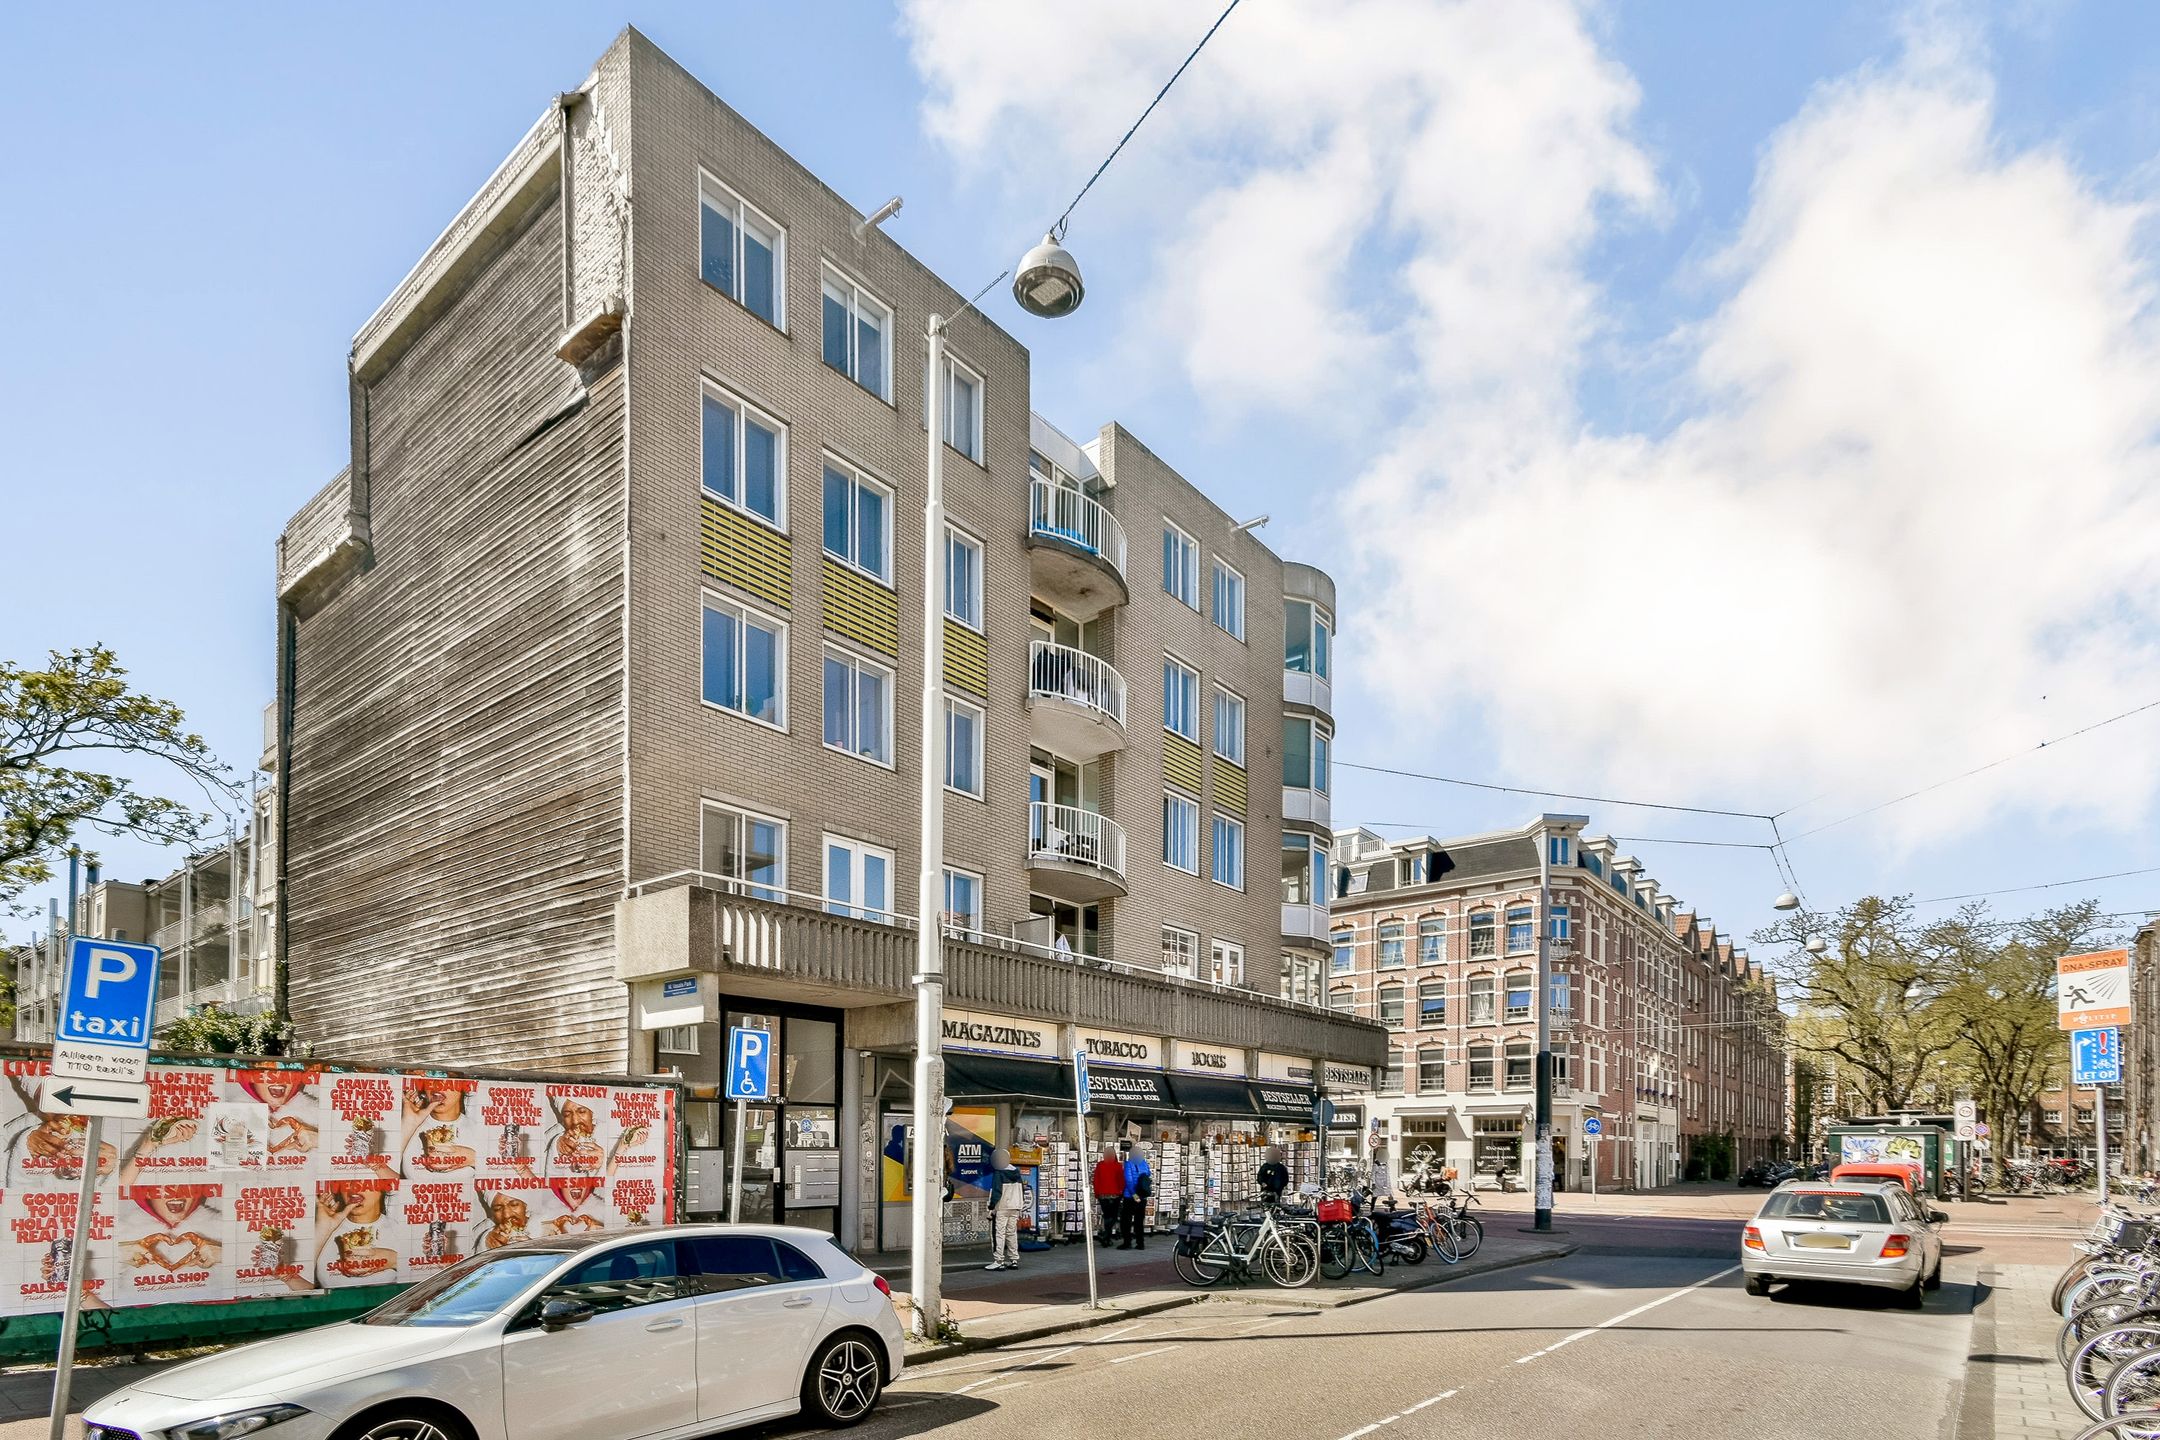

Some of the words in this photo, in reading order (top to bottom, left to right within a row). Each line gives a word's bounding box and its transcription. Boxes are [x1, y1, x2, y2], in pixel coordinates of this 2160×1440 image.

[2062, 957, 2125, 972] DNA-SPRAY
[85, 948, 138, 999] P
[71, 1010, 140, 1037] taxi
[942, 1020, 1041, 1048] MAGAZINES
[740, 1033, 762, 1069] P
[1086, 1038, 1147, 1060] TOBACCO
[59, 1051, 104, 1062] Alleen
[111, 1057, 141, 1066] voor
[1192, 1051, 1227, 1069] BOOKS
[4, 1059, 52, 1077] LIVE
[144, 1072, 163, 1084] LL
[164, 1072, 183, 1084] OF
[186, 1073, 214, 1085] THE
[1325, 1067, 1372, 1085] BESTSELLER
[2078, 1071, 2097, 1080] LET
[2100, 1070, 2116, 1079] OP
[148, 1084, 213, 1096] UMMMM.
[336, 1079, 375, 1090] CRAVE
[377, 1080, 391, 1090] IT.
[402, 1078, 433, 1091] LIVE
[434, 1080, 479, 1092] SAUCY
[1088, 1076, 1157, 1092] ESTSELLER
[330, 1089, 353, 1100] GET
[355, 1089, 394, 1100] MESSY.
[488, 1087, 535, 1098] GOODBYE
[546, 1085, 571, 1097] LIVE
[573, 1086, 607, 1099] SAUCY
[614, 1093, 629, 1101] ALL
[631, 1094, 641, 1102] OF
[642, 1094, 658, 1102] THE
[1089, 1092, 1115, 1100] AGAZINES
[1260, 1090, 1312, 1105] BESTSELLER
[149, 1097, 168, 1107] NE
[170, 1097, 189, 1107] OF
[191, 1097, 220, 1108] THE
[332, 1100, 359, 1110] FEEL
[361, 1100, 393, 1111] GOOD
[492, 1098, 505, 1107] TO
[506, 1098, 533, 1108] JUNK.
[341, 1111, 384, 1121] AFTER.
[482, 1106, 509, 1117] HOLA
[511, 1106, 523, 1116] TO
[524, 1107, 542, 1117] THE
[611, 1110, 632, 1119] NONE
[634, 1110, 643, 1119] OF
[643, 1111, 660, 1120] THE
[512, 1117, 541, 1126] DEAL.
[1332, 1113, 1357, 1123] LIER
[958, 1144, 981, 1156] ATM
[22, 1157, 68, 1169] SALSA
[68, 1156, 107, 1168] SP
[135, 1157, 175, 1168] SALSA
[239, 1156, 276, 1167] SALA
[278, 1156, 306, 1166] SHOP
[331, 1155, 364, 1165] SALSA
[365, 1154, 392, 1165] SHOP
[411, 1156, 440, 1166] SALSA
[442, 1156, 467, 1165] SHOP
[486, 1157, 512, 1165] SALSA
[513, 1157, 536, 1165] SHOP
[553, 1156, 577, 1165] SALSA
[579, 1156, 599, 1165] SHOP
[615, 1156, 637, 1164] SALSA
[638, 1156, 656, 1164] SHOP
[316, 1180, 350, 1193] LIVE
[351, 1178, 400, 1192] SAUCY
[412, 1183, 463, 1194] GOODBYE
[474, 1179, 502, 1191] LIVE
[504, 1178, 542, 1190] SAUCY
[616, 1180, 641, 1188] CRAVE
[643, 1179, 653, 1188] IT.
[241, 1186, 285, 1199] CRAVE
[287, 1186, 302, 1197] IT.
[415, 1194, 428, 1204] TO
[430, 1193, 461, 1204] JUNK.
[612, 1188, 629, 1197] GET
[630, 1188, 656, 1197] MESSY.
[22, 1192, 102, 1206] GOODBE
[234, 1199, 260, 1211] GET
[262, 1197, 306, 1209] MESSY.
[613, 1199, 632, 1207] FEEL
[634, 1198, 655, 1207] GOOD
[28, 1205, 50, 1218] TO
[52, 1205, 99, 1218] JUN.
[237, 1210, 267, 1222] FEEL
[269, 1207, 305, 1220] GOOD
[404, 1203, 434, 1215] HOLA
[436, 1203, 449, 1213] TO
[450, 1202, 471, 1213] THE
[620, 1206, 649, 1215] AFTER.
[438, 1213, 469, 1222] DEAL.
[11, 1217, 58, 1231] HOLA
[247, 1219, 295, 1232] AFTER.
[65, 1228, 112, 1241] DAL.
[361, 1258, 388, 1269] SHOP
[409, 1256, 438, 1266] SALSA
[440, 1254, 464, 1264] SHOP
[236, 1268, 273, 1279] SALSA
[274, 1264, 303, 1275] SHOP
[134, 1275, 175, 1287] SALSA
[177, 1272, 209, 1284] SHOP
[20, 1282, 65, 1295] SALSA
